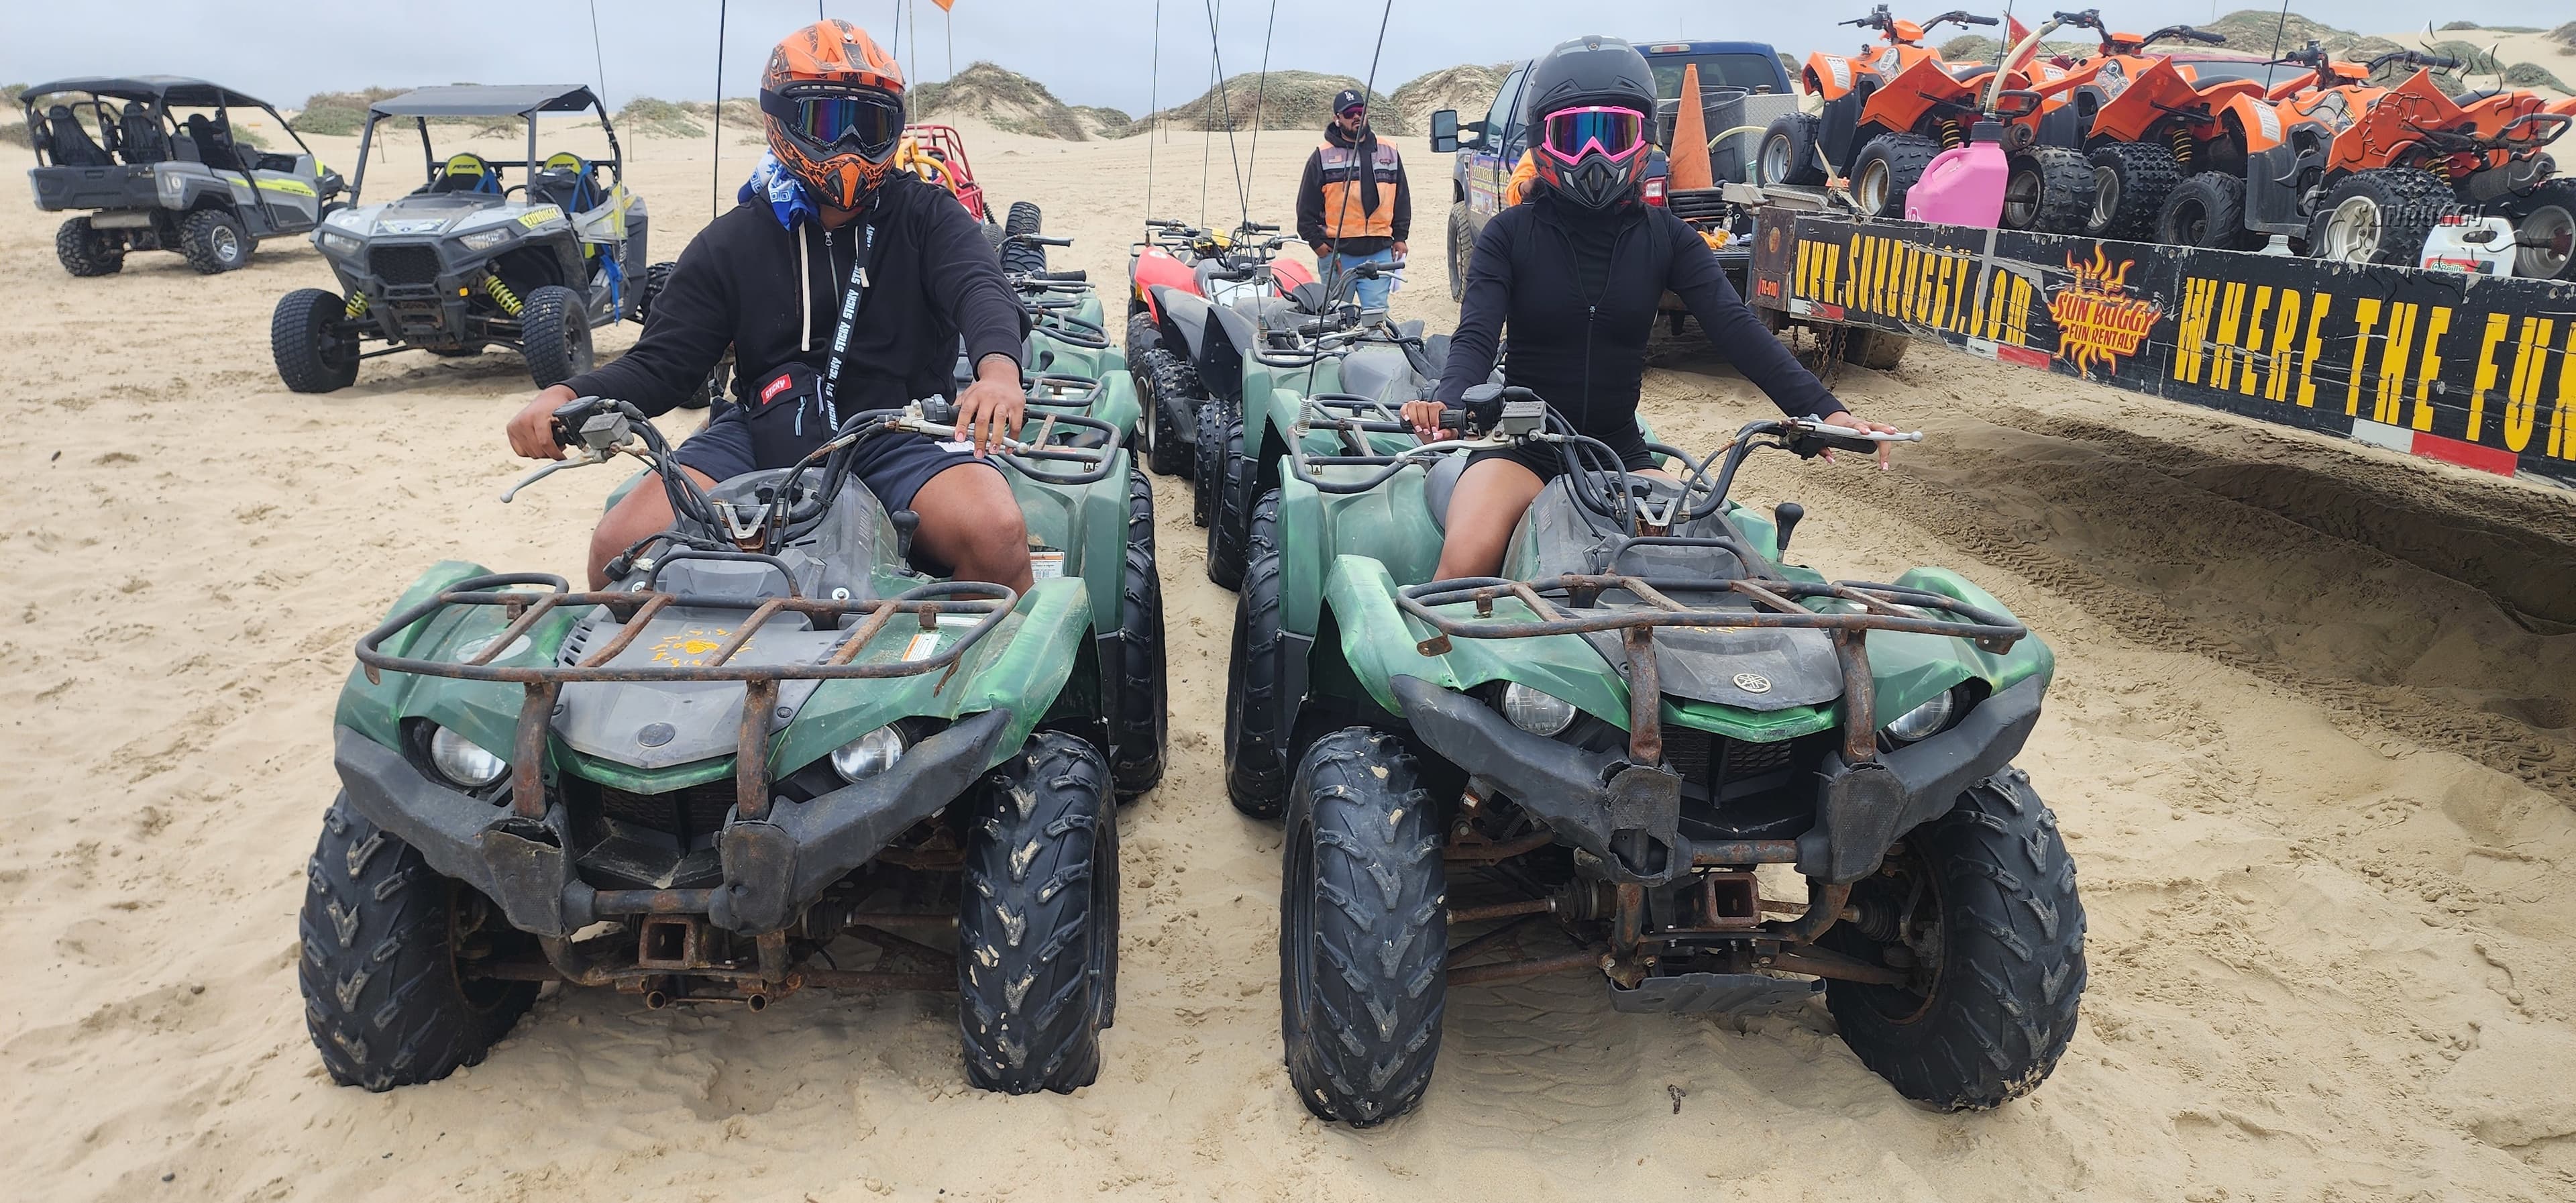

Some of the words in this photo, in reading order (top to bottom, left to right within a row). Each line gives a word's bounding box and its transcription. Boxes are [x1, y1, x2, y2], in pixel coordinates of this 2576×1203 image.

[1344, 91, 1355, 101] LA
[1795, 233, 2033, 348] WWW.SUNBUGGY.COM
[2055, 294, 2090, 323] SUN
[2093, 302, 2161, 333] BUGGY
[2069, 323, 2090, 342] FUN
[2091, 327, 2137, 350] RENTALS
[2174, 277, 2332, 408] WHERE
[2345, 298, 2453, 432] THE
[827, 400, 839, 431] STICKY
[835, 321, 851, 352] STICKY
[843, 289, 859, 319] STICKY
[765, 378, 786, 399] STICKY
